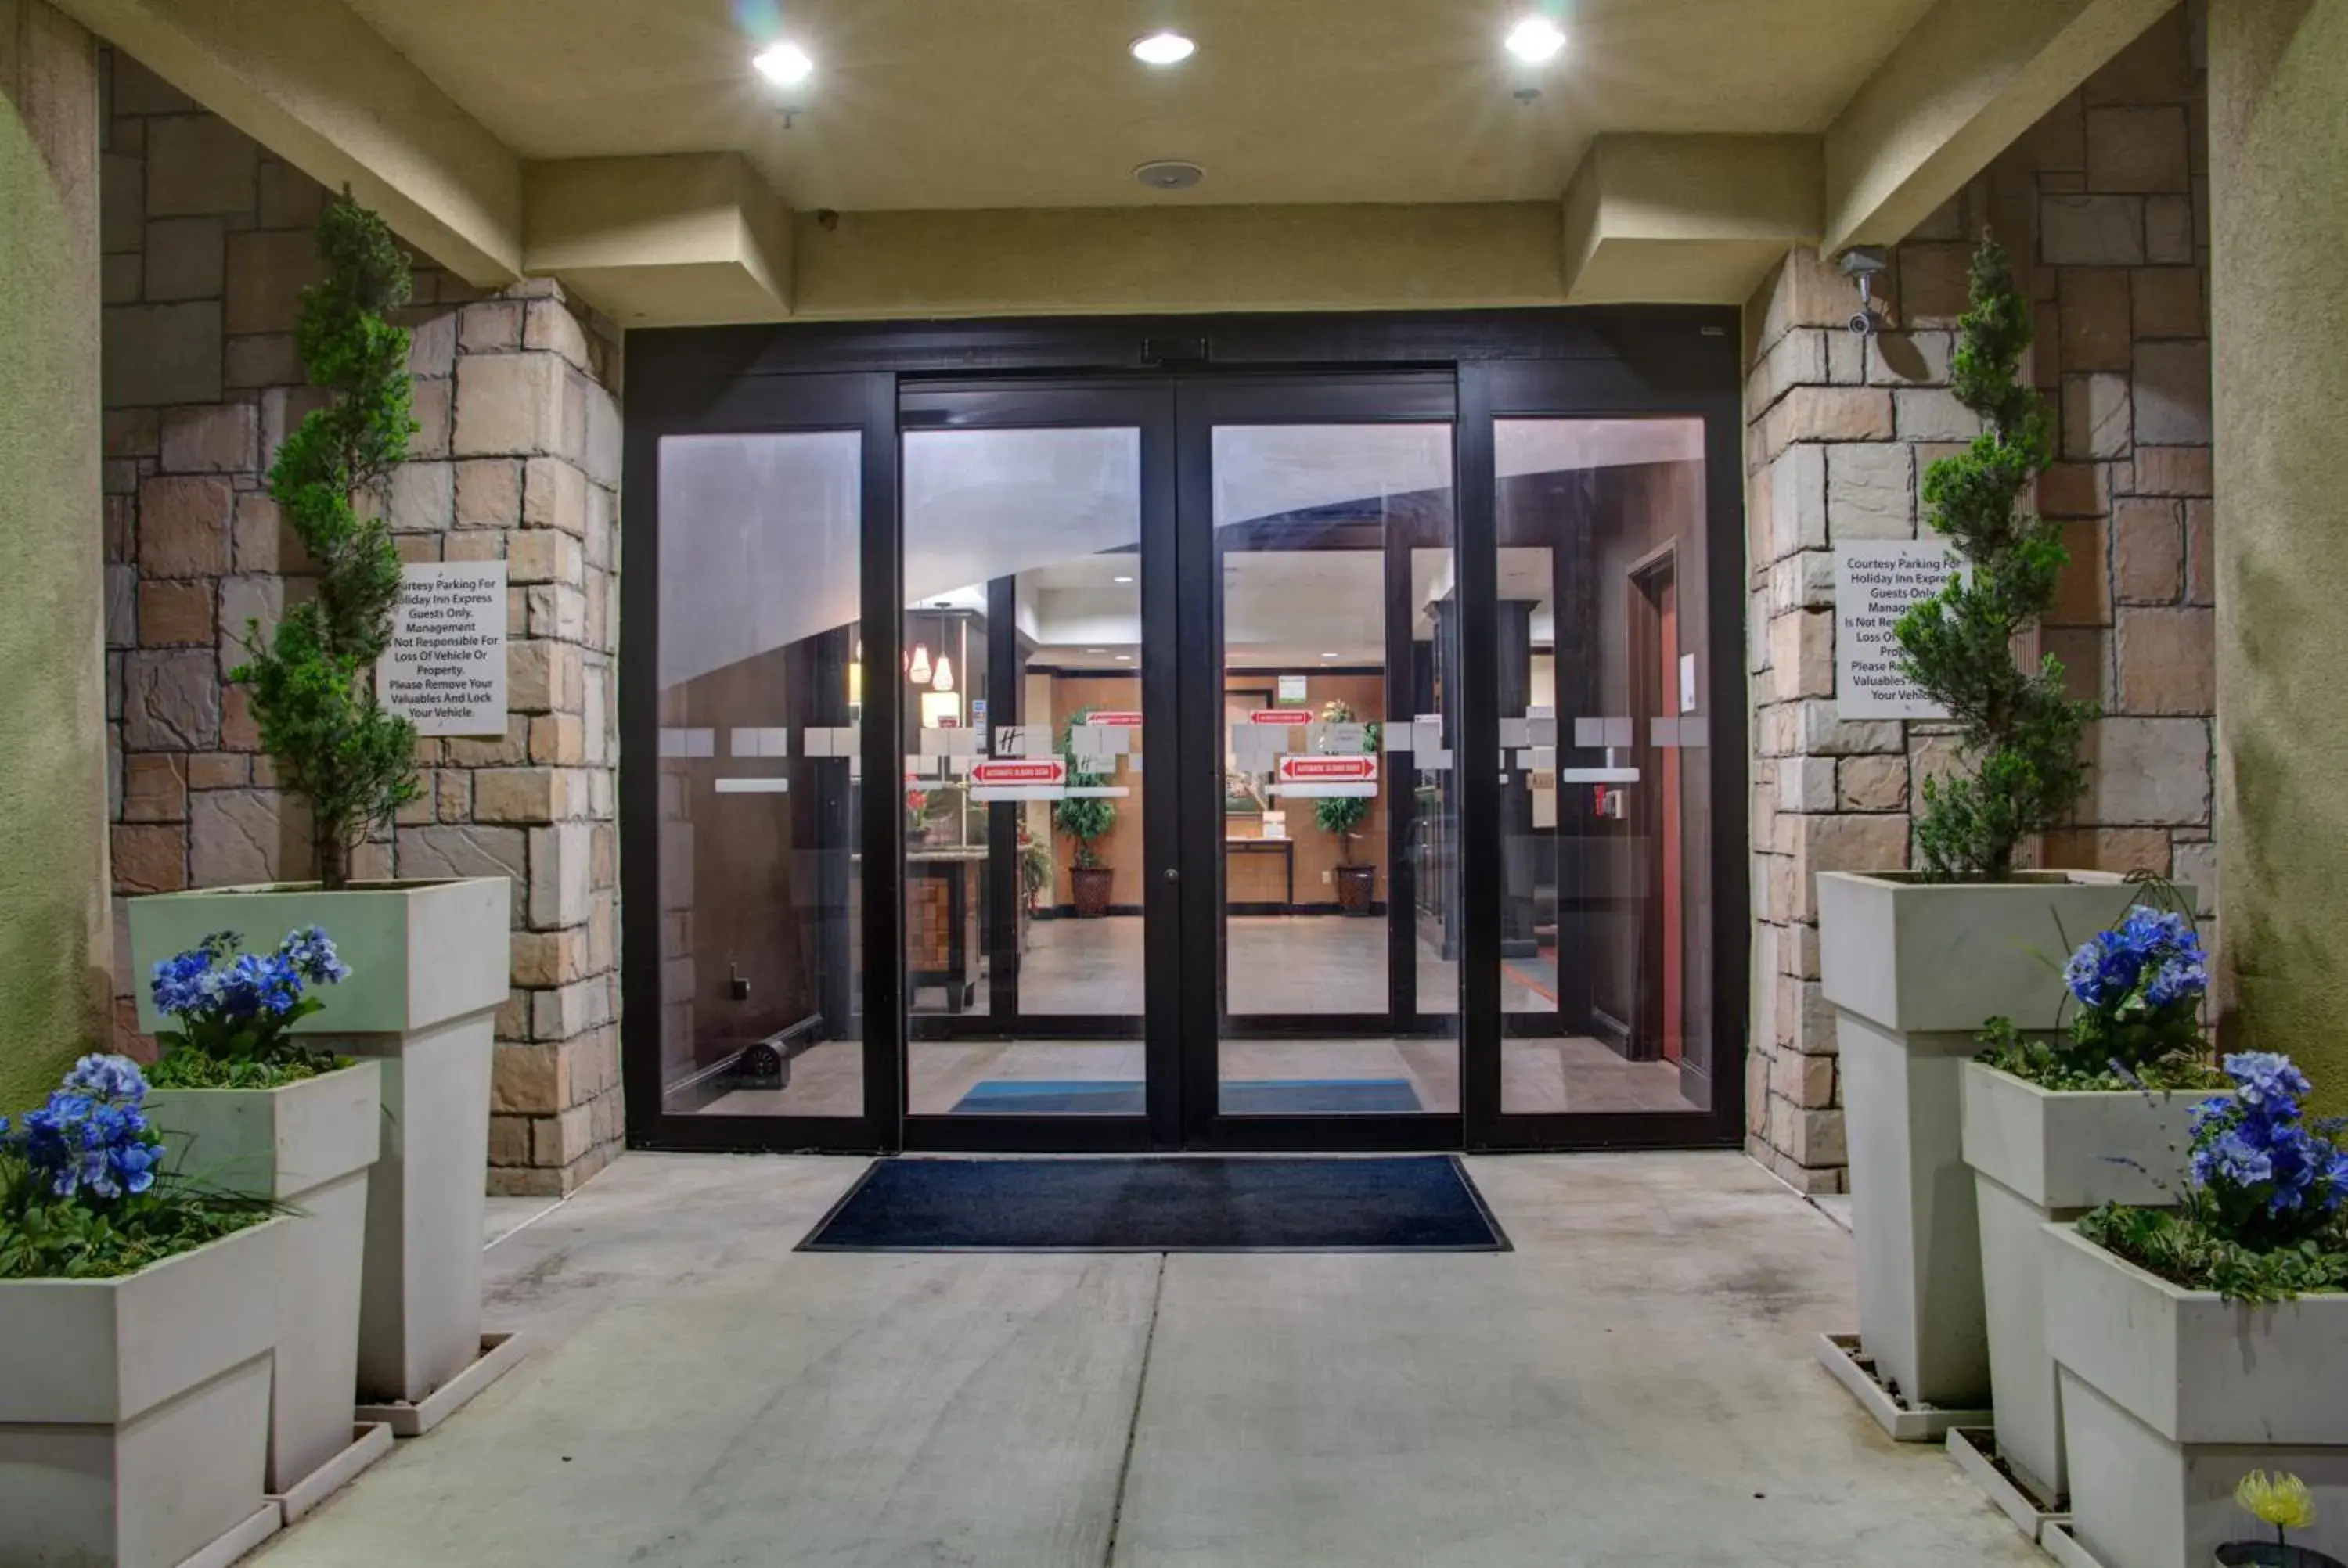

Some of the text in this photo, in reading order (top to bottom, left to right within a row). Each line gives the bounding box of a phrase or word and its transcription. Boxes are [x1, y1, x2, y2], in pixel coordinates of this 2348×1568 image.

[1847, 558, 1896, 571] Courtesy
[1899, 558, 1940, 572] Parking
[437, 579, 476, 592] Parking
[479, 578, 495, 588] For
[1851, 574, 1947, 585] Holiday Inn Expre
[1871, 588, 1907, 599] Guests
[433, 595, 449, 604] Inn
[452, 594, 492, 605] Express
[409, 607, 474, 619] Guests Only.
[1845, 617, 1853, 627] Is
[1856, 617, 1876, 627] Not
[406, 623, 476, 635] Management
[394, 638, 413, 647] Not
[416, 637, 479, 648] Responsible
[481, 635, 499, 646] For
[1856, 631, 1881, 642] Loss
[394, 650, 487, 662] Loss Of Vehicle Or
[417, 664, 465, 676] Property.
[1851, 661, 1886, 671] Please
[389, 678, 492, 689] Please Remove Your
[1853, 676, 1906, 686] Valuables
[391, 692, 492, 704] Valuables And Lock
[1871, 690, 1896, 700] Your
[409, 707, 475, 717] Your Vehicle.
